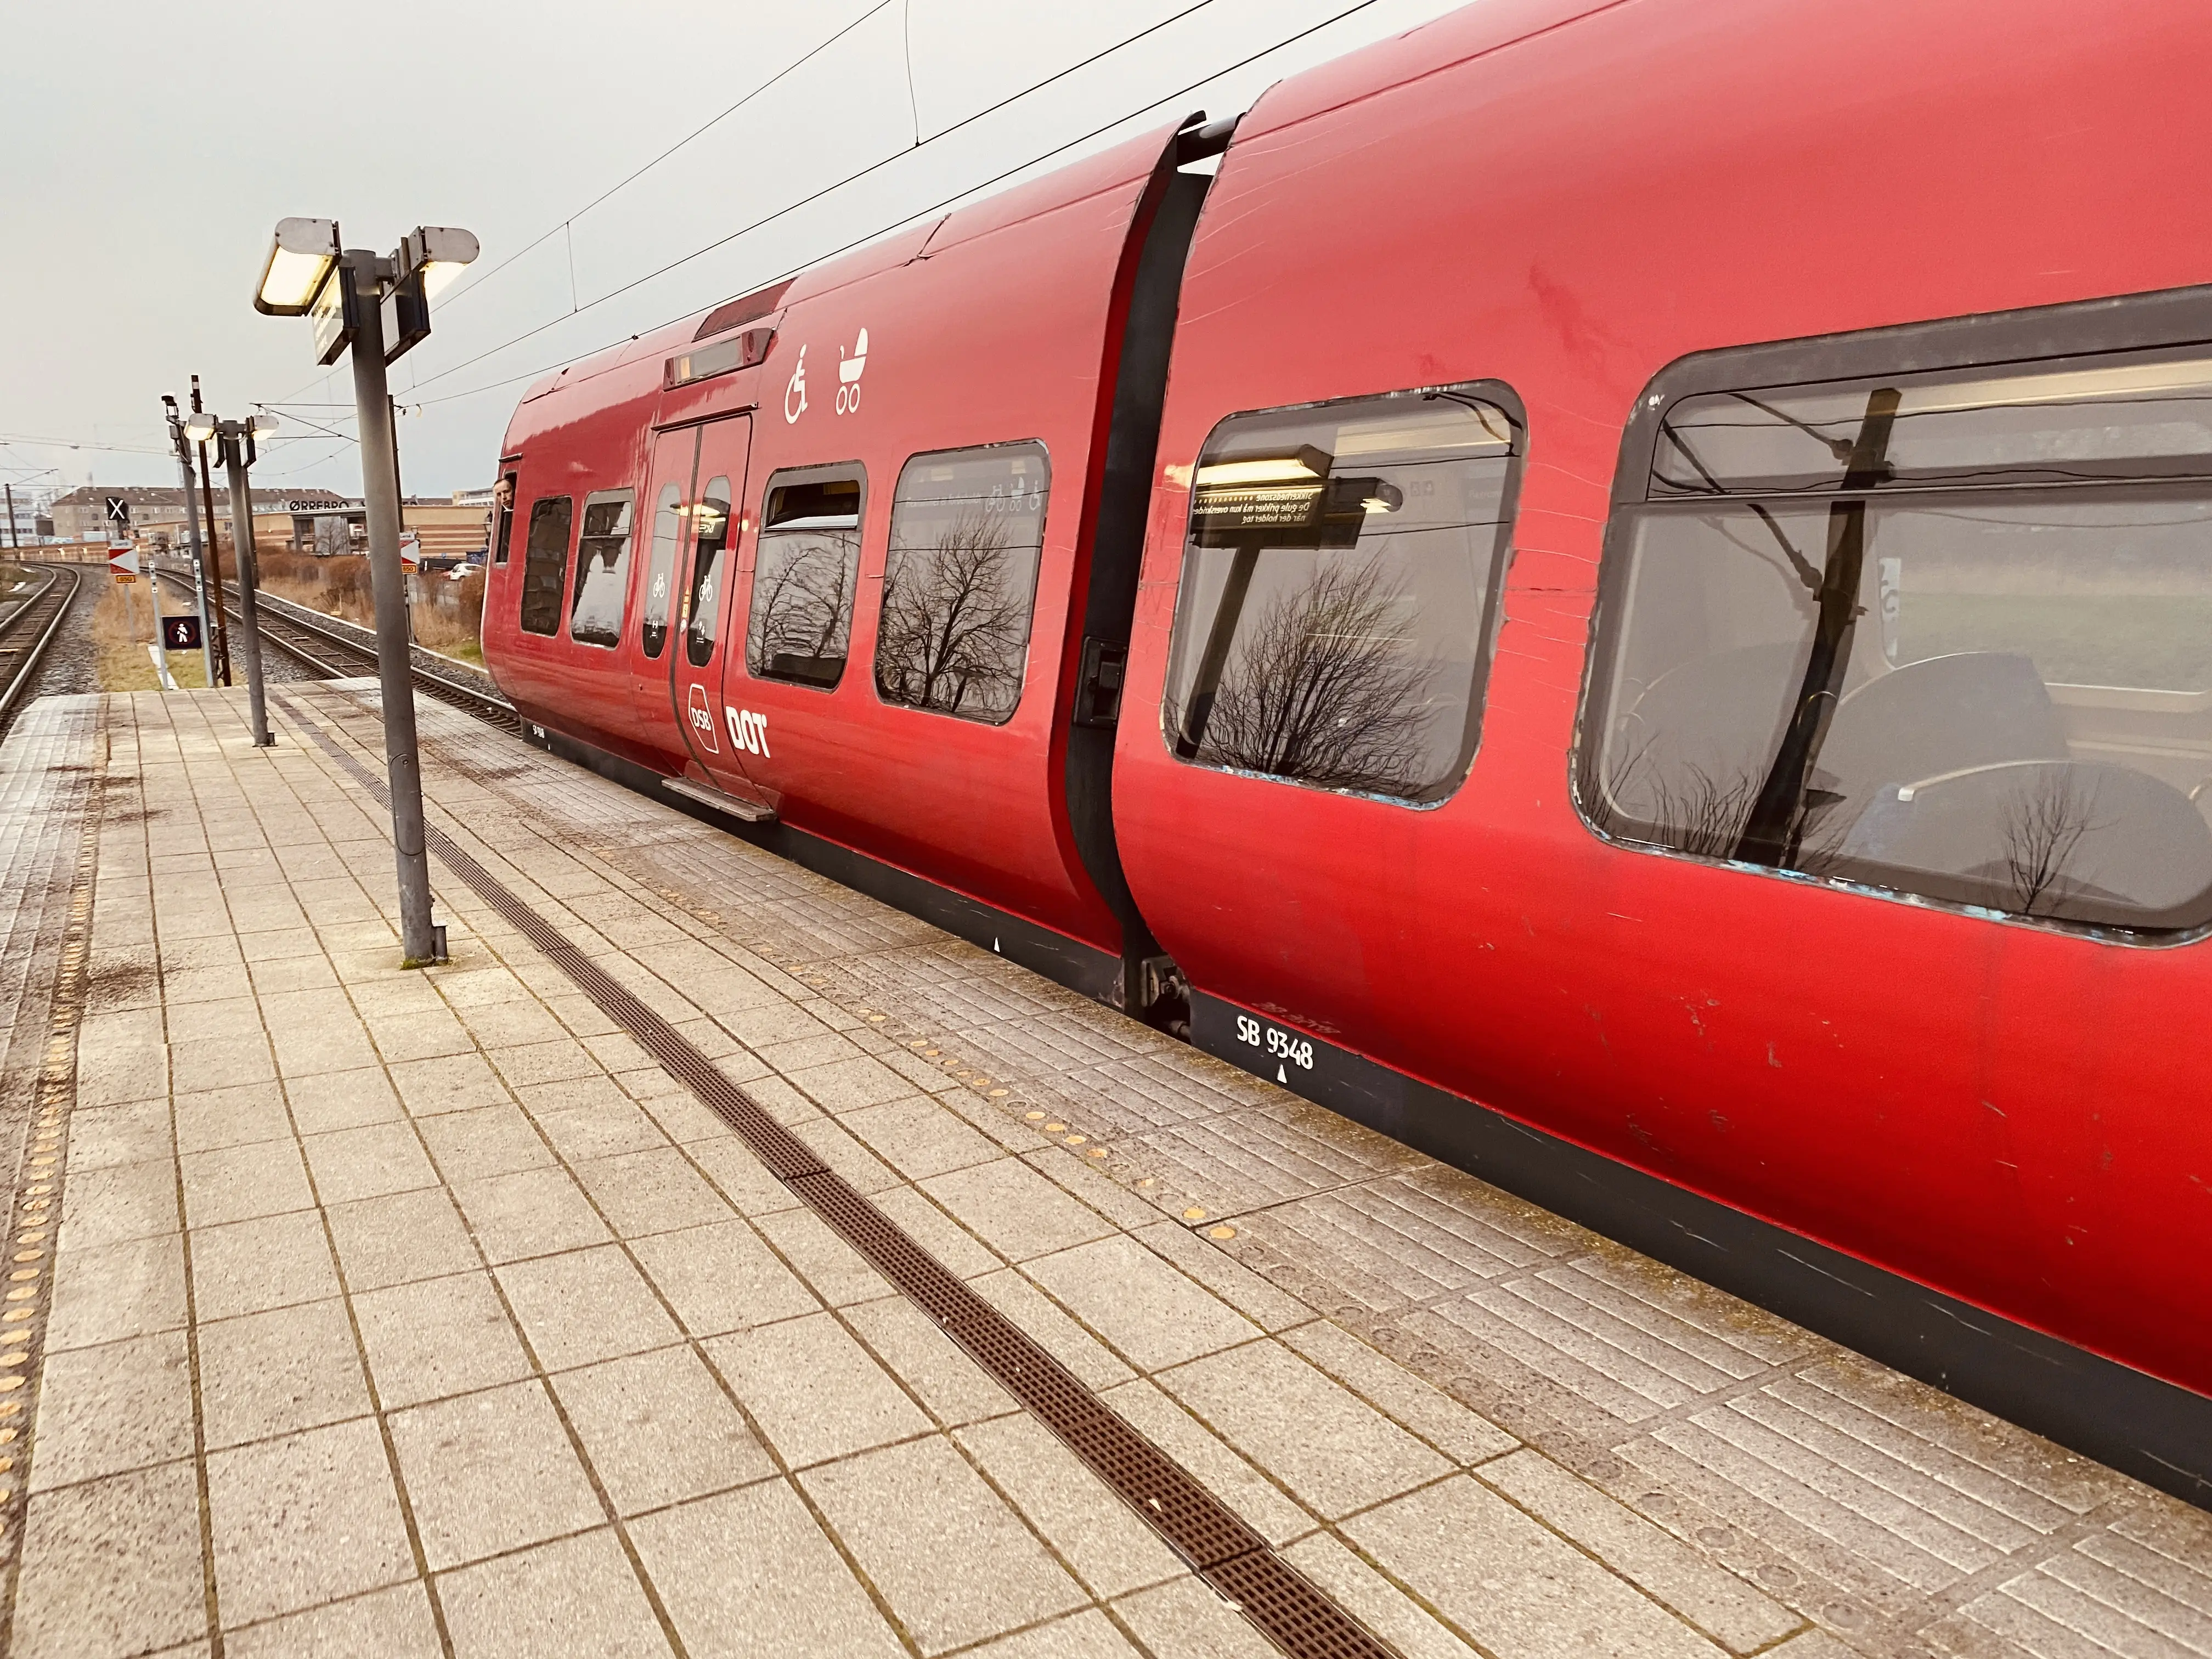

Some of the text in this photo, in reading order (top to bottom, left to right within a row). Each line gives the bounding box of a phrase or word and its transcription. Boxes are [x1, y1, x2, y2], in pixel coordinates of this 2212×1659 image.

[691, 707, 712, 731] DSB
[725, 706, 771, 759] DOT
[1237, 1015, 1313, 1070] SB 9348
